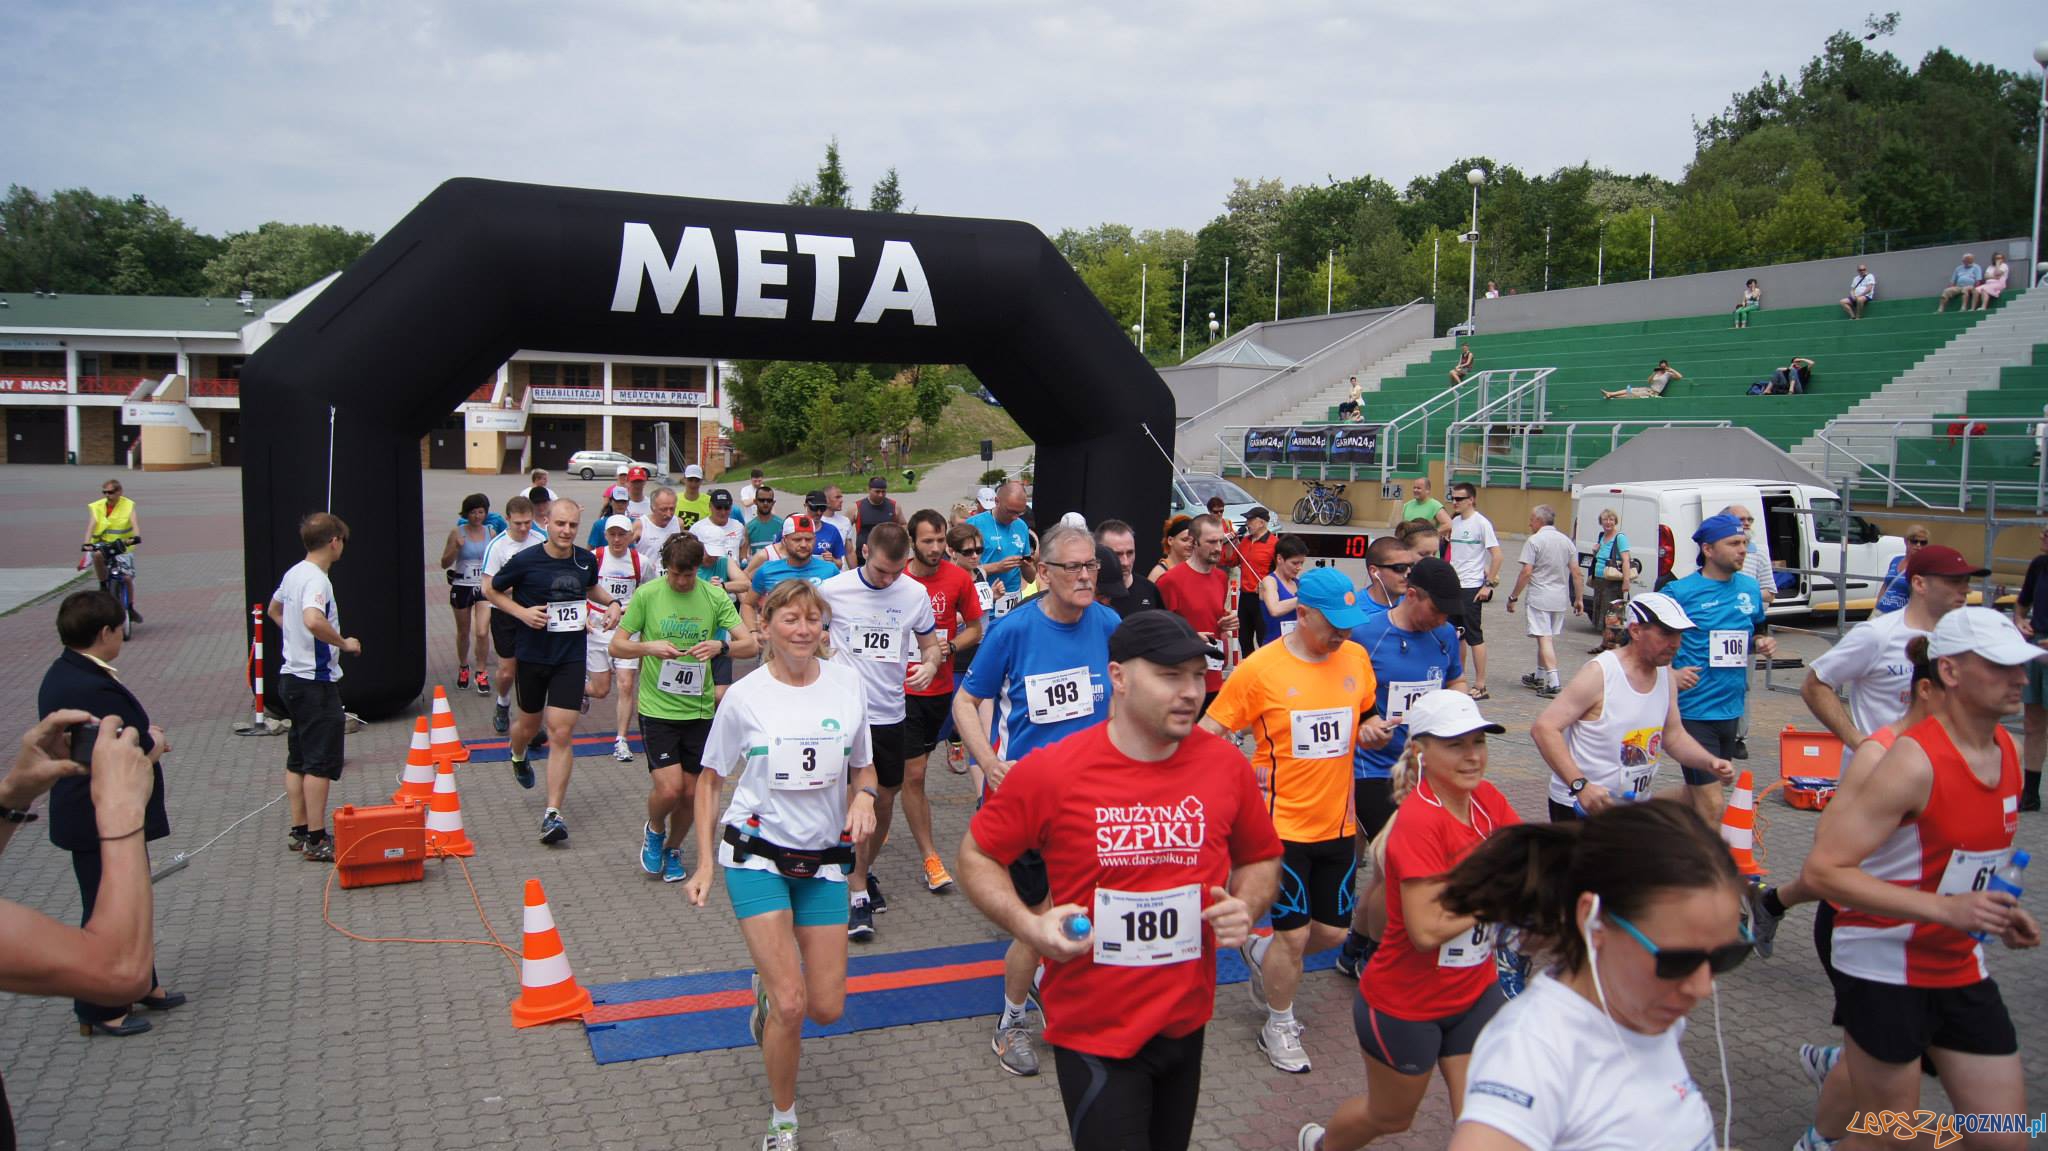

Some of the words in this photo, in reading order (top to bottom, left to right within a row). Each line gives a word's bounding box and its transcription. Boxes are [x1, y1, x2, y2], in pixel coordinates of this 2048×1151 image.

[611, 222, 937, 326] META
[21, 379, 67, 391] MASAŻ
[534, 388, 601, 398] REHABILITACJA
[619, 391, 666, 400] MEDYCYNA
[671, 392, 699, 401] PRACY
[1346, 535, 1365, 557] 10
[473, 568, 483, 577] 11
[610, 583, 628, 594] 183
[557, 607, 578, 621] 125
[863, 632, 890, 649] 126
[1722, 639, 1743, 655] 106
[675, 670, 694, 685] 40
[1044, 681, 1079, 707] 193
[1310, 721, 1340, 743] 191
[802, 747, 816, 772] 3
[1095, 802, 1187, 824] DRUŻYNA
[1096, 822, 1206, 853] SZPIKU
[1099, 853, 1198, 867] www.darszpiku.pl
[1121, 908, 1178, 942] 180
